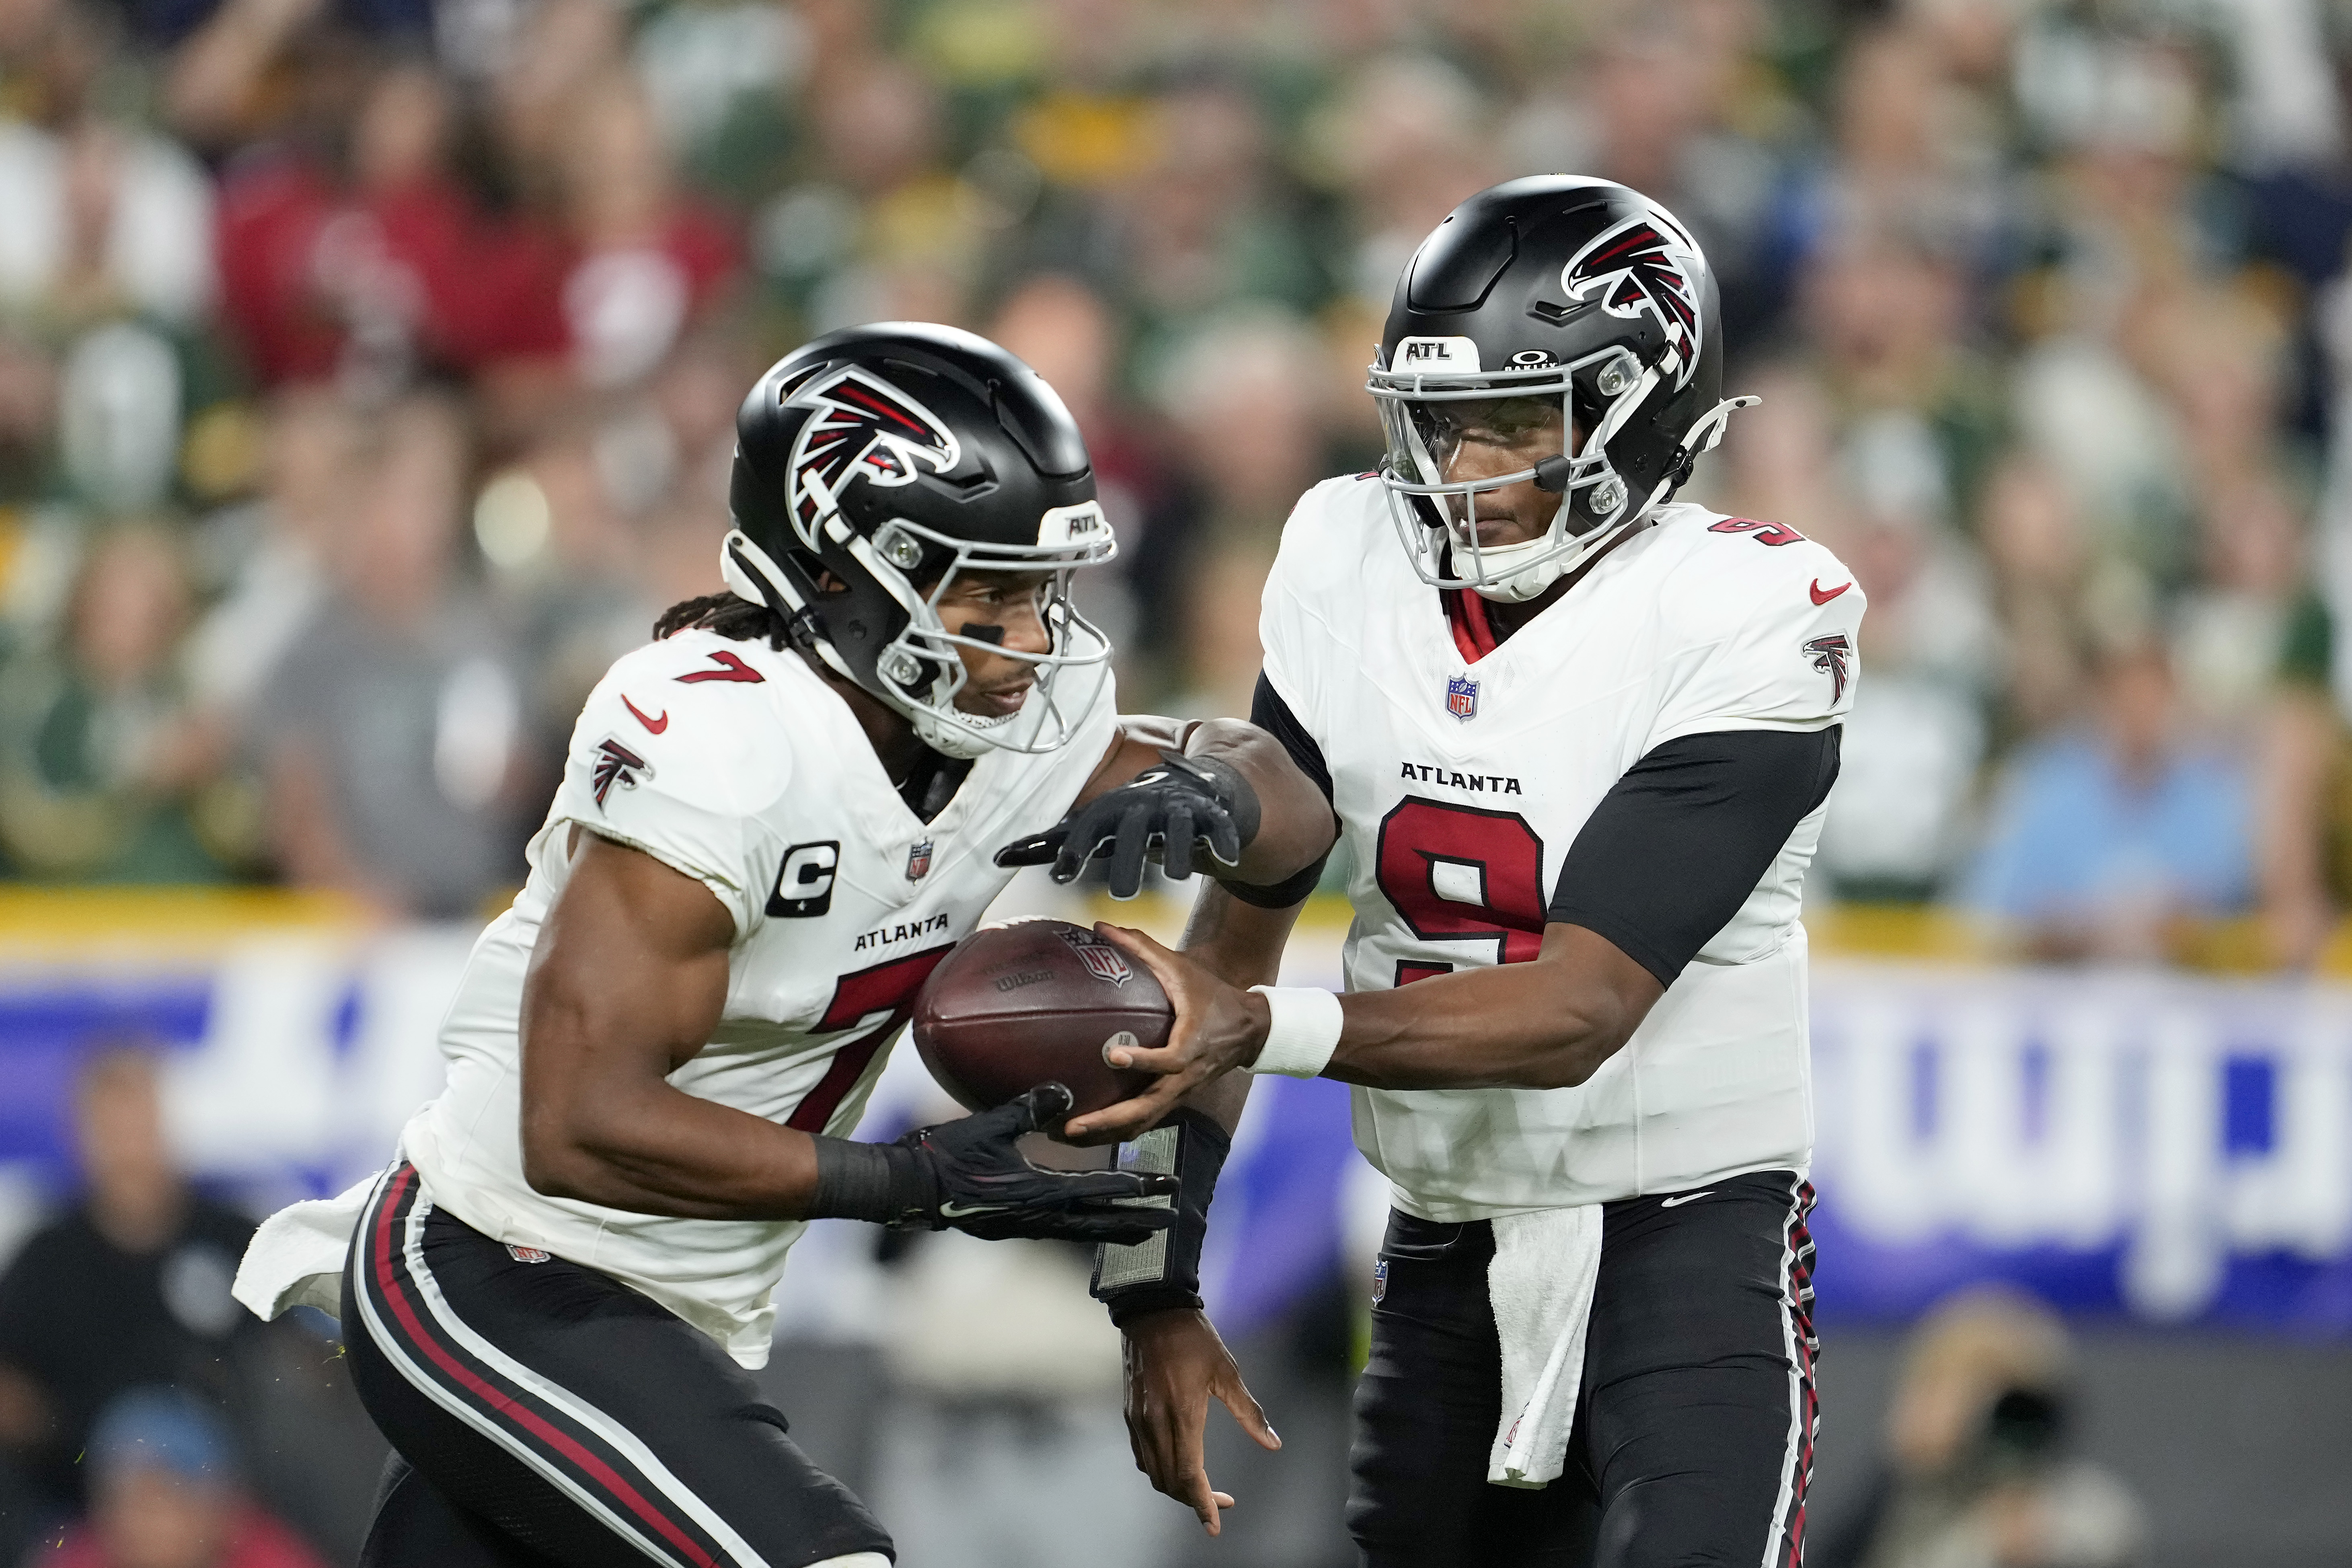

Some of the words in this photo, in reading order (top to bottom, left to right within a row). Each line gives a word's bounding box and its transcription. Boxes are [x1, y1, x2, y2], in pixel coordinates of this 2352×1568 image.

[1407, 341, 1452, 365] ATL
[673, 650, 766, 683] 7
[1449, 694, 1471, 715] NFL
[1401, 761, 1522, 795] ATLANTA
[779, 845, 836, 900] C
[1375, 794, 1548, 988] 9
[855, 913, 949, 951] ATLANTA
[1081, 947, 1127, 975] NFL
[996, 970, 1056, 992] Wilson
